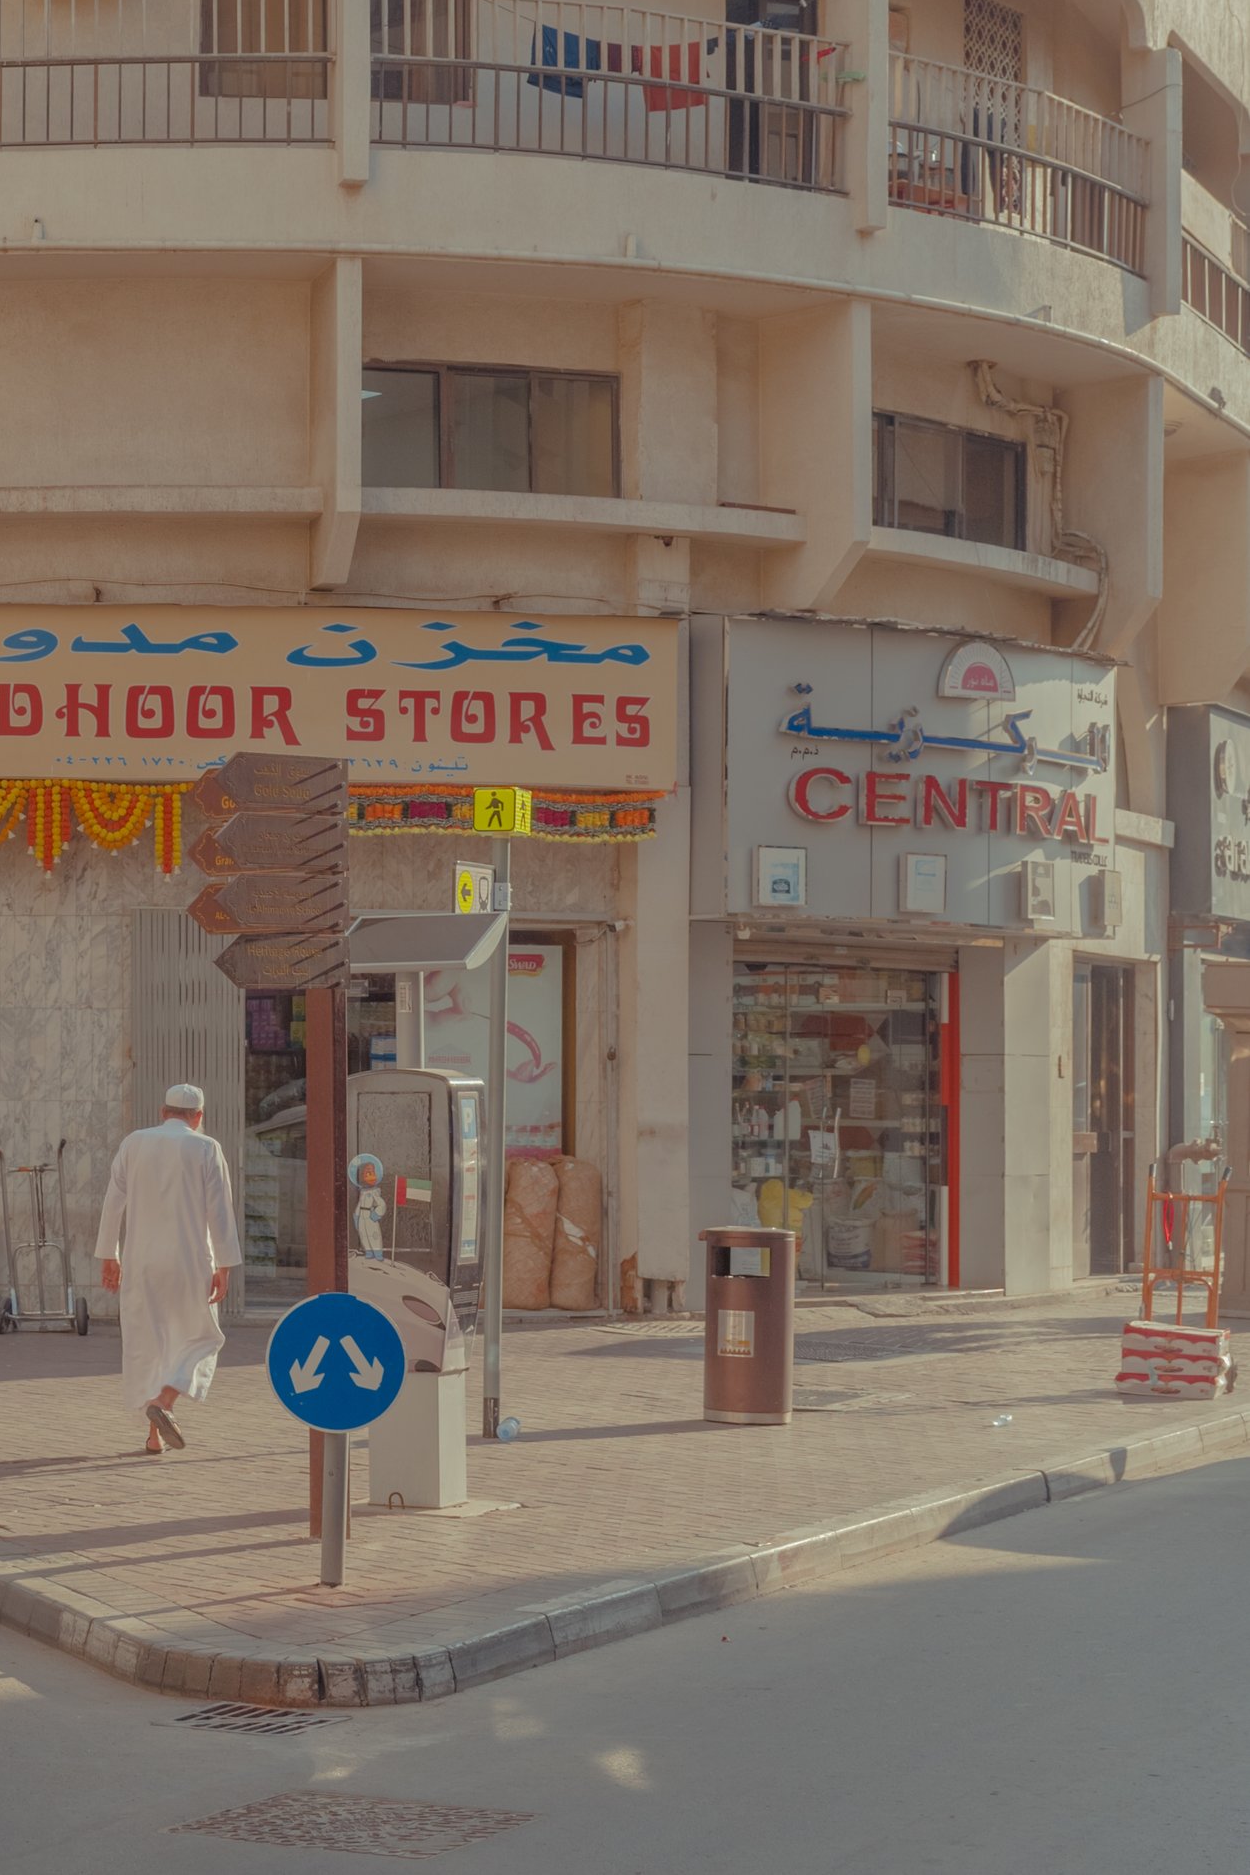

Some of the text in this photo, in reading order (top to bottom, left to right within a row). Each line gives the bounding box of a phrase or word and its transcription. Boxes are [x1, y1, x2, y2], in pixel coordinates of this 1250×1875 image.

[285, 620, 651, 671] مخزن
[345, 688, 651, 751] STORES
[253, 783, 280, 798] Gold
[787, 766, 1111, 846] CENTRAL
